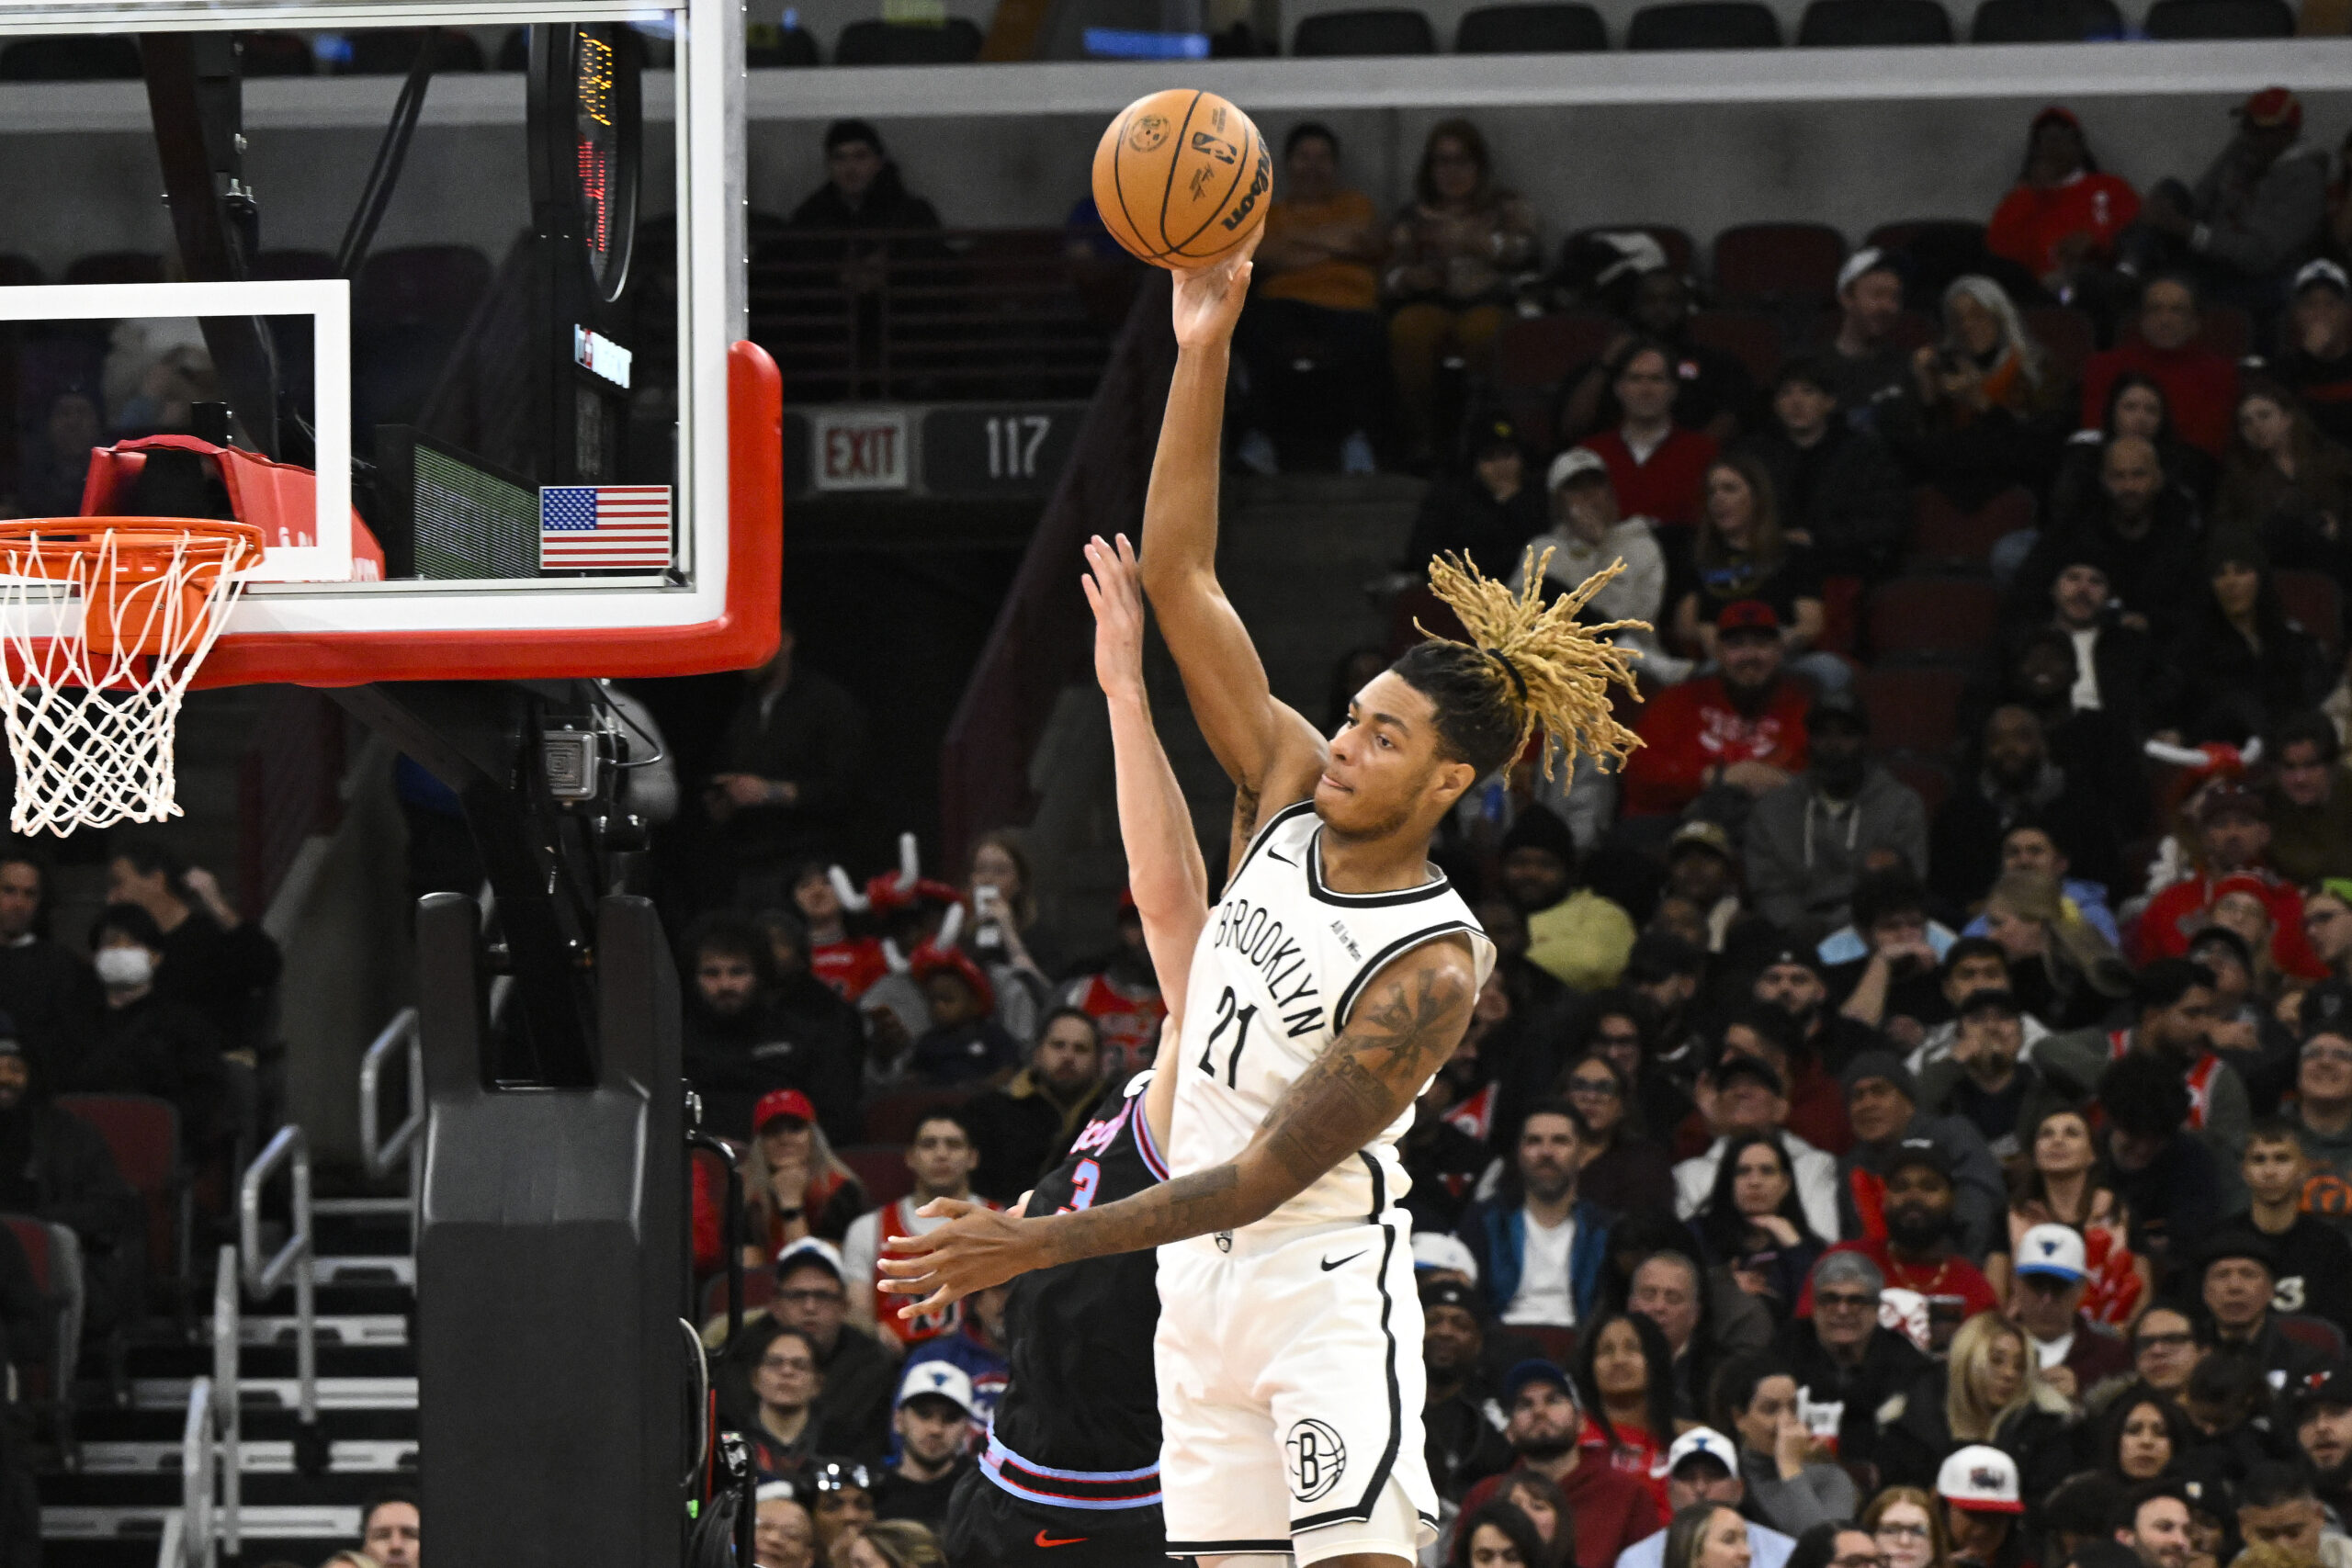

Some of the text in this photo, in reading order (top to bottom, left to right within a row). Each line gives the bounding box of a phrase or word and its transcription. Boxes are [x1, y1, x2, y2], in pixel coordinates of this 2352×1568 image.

[826, 427, 897, 478] EXIT
[986, 416, 1050, 479] 117
[1215, 898, 1325, 1038] BROOKLYN
[1198, 986, 1258, 1090] 21
[1299, 1431, 1319, 1490] B
